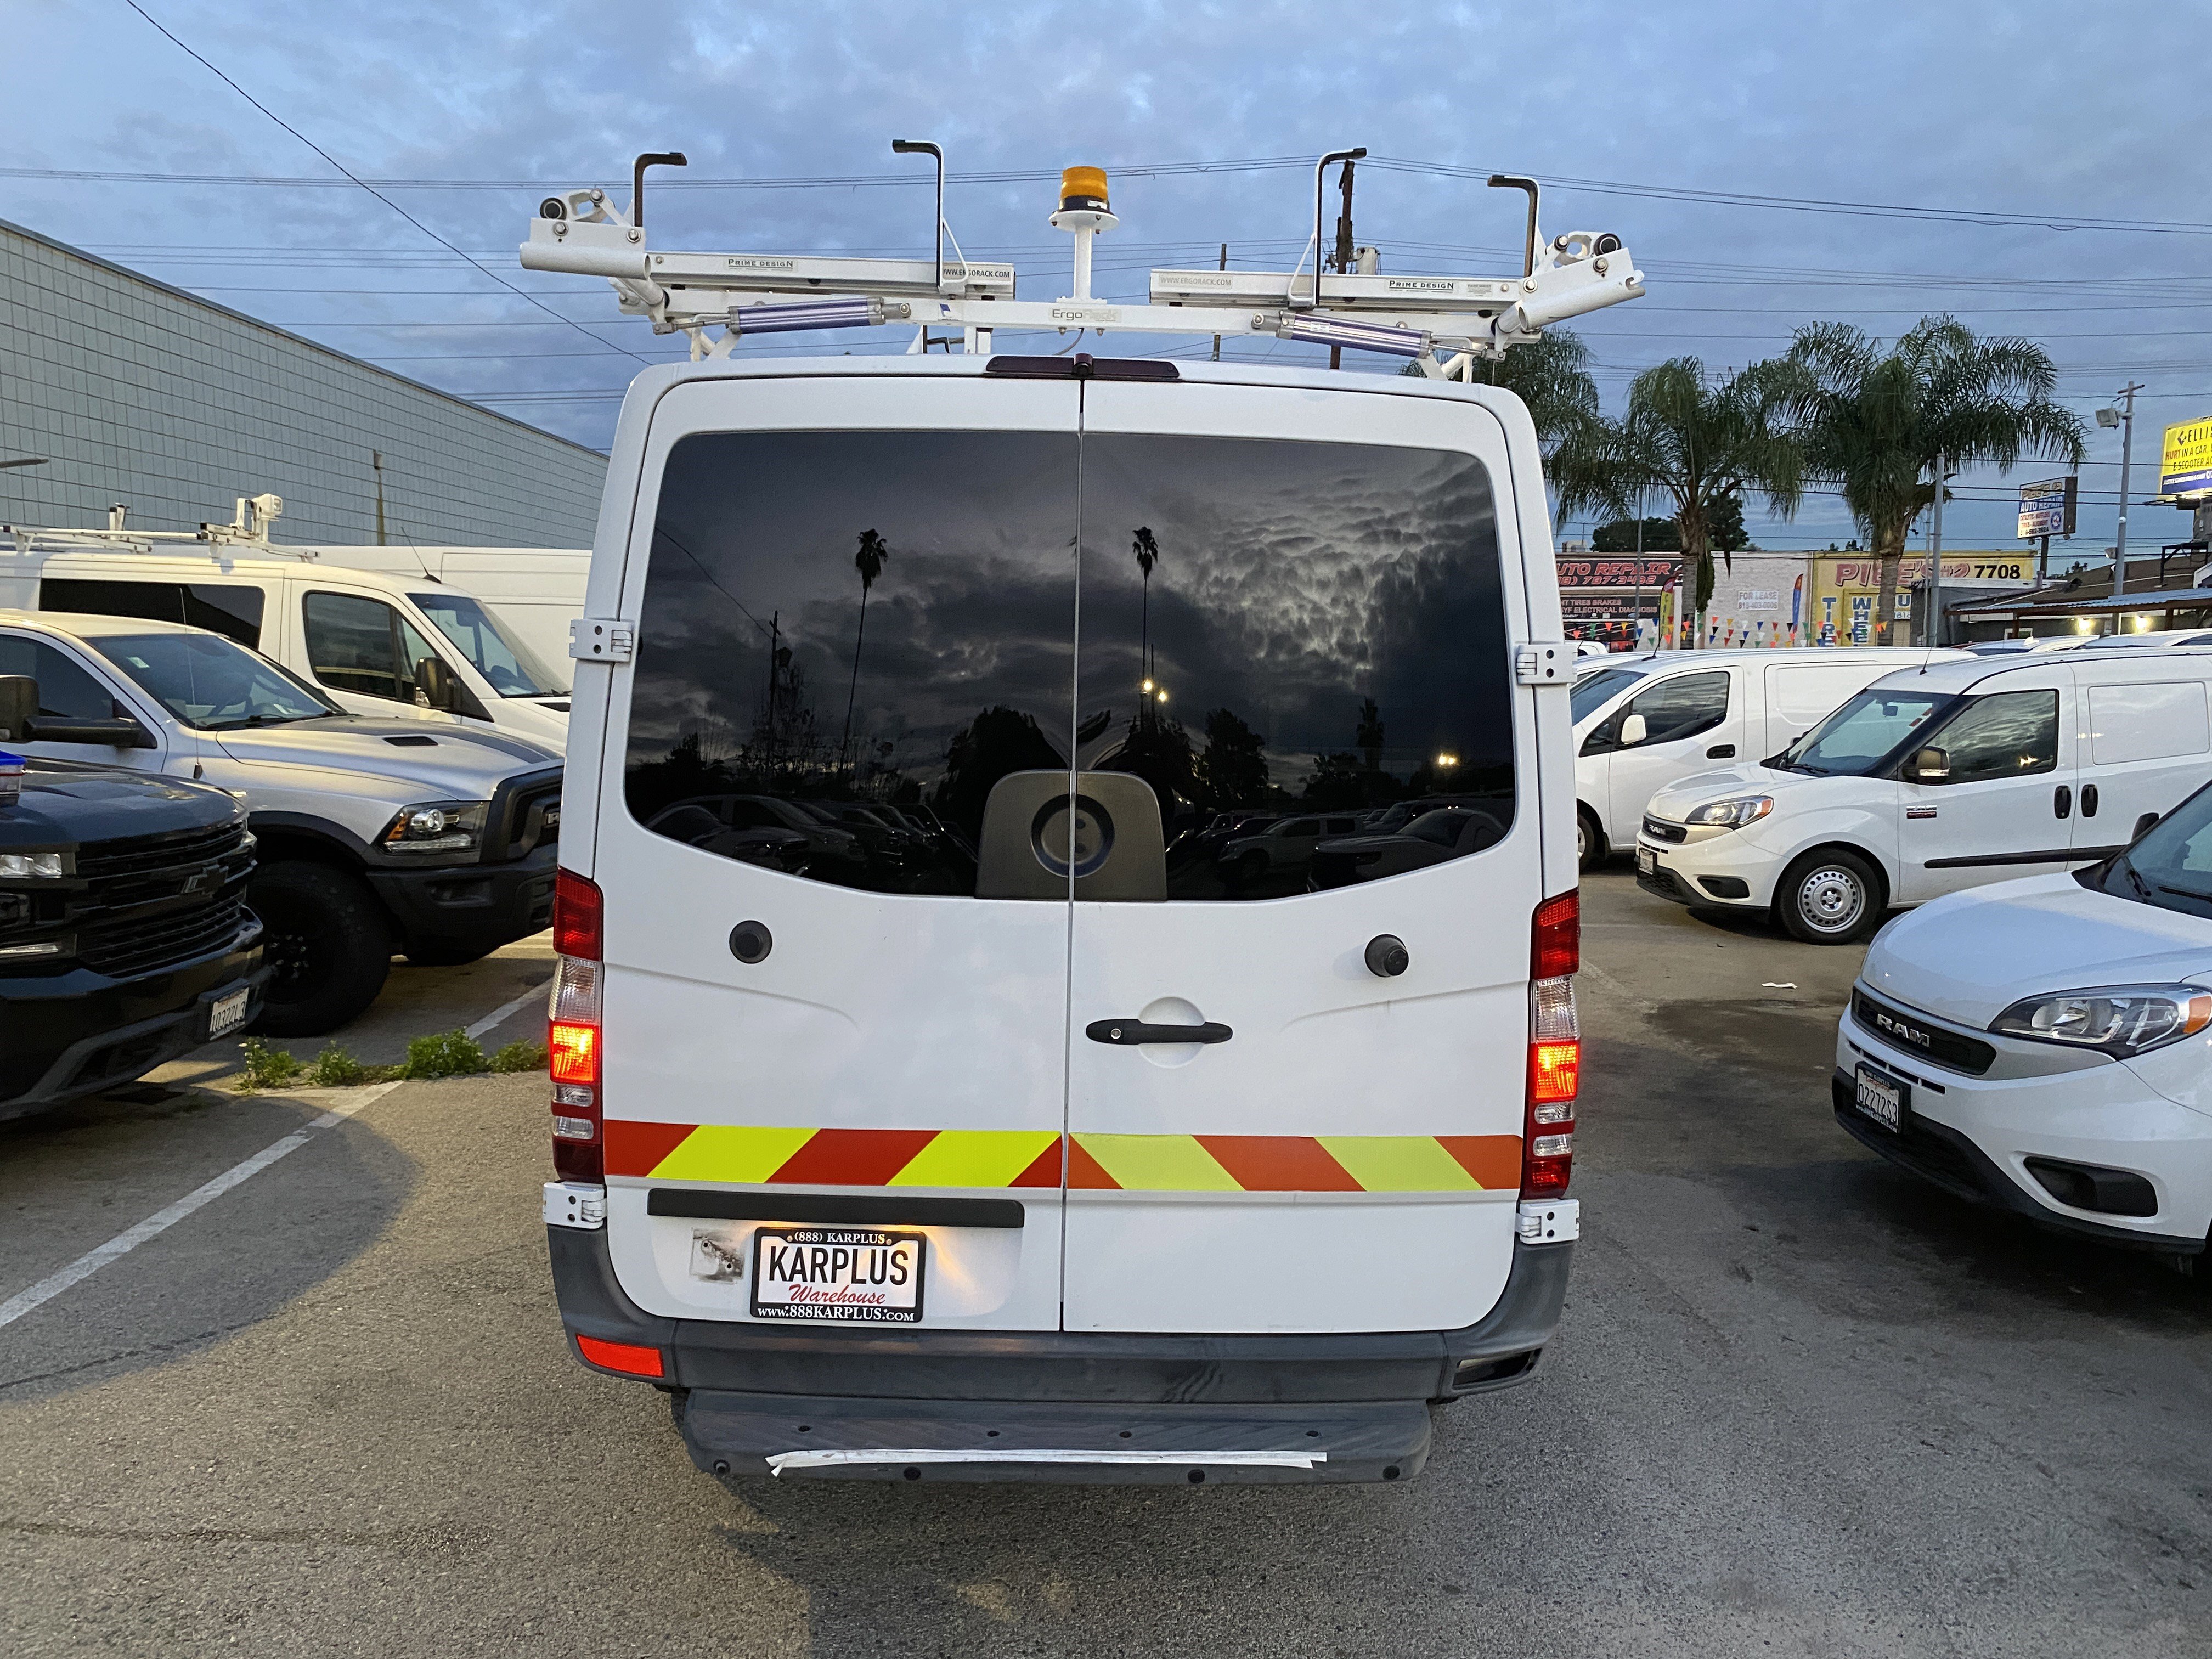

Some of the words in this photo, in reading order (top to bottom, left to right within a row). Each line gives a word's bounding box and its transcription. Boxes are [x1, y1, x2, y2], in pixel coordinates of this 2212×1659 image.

[1160, 276, 1232, 286] WWW.ERGORACK.COM
[1389, 280, 1417, 288] PRIME
[1556, 562, 1591, 575] UTO
[1594, 562, 1671, 575] REPAIR
[1974, 564, 2021, 579] 7708
[1739, 591, 1753, 600] FOR
[1853, 597, 1872, 646] WHEE
[1877, 1013, 1930, 1047] RAM
[1859, 1083, 1898, 1124] 02272S3
[794, 1231, 823, 1243] (888)
[827, 1232, 885, 1244] KARPLUS
[769, 1246, 909, 1285] KARPLUS
[788, 1284, 885, 1305] Warehouse
